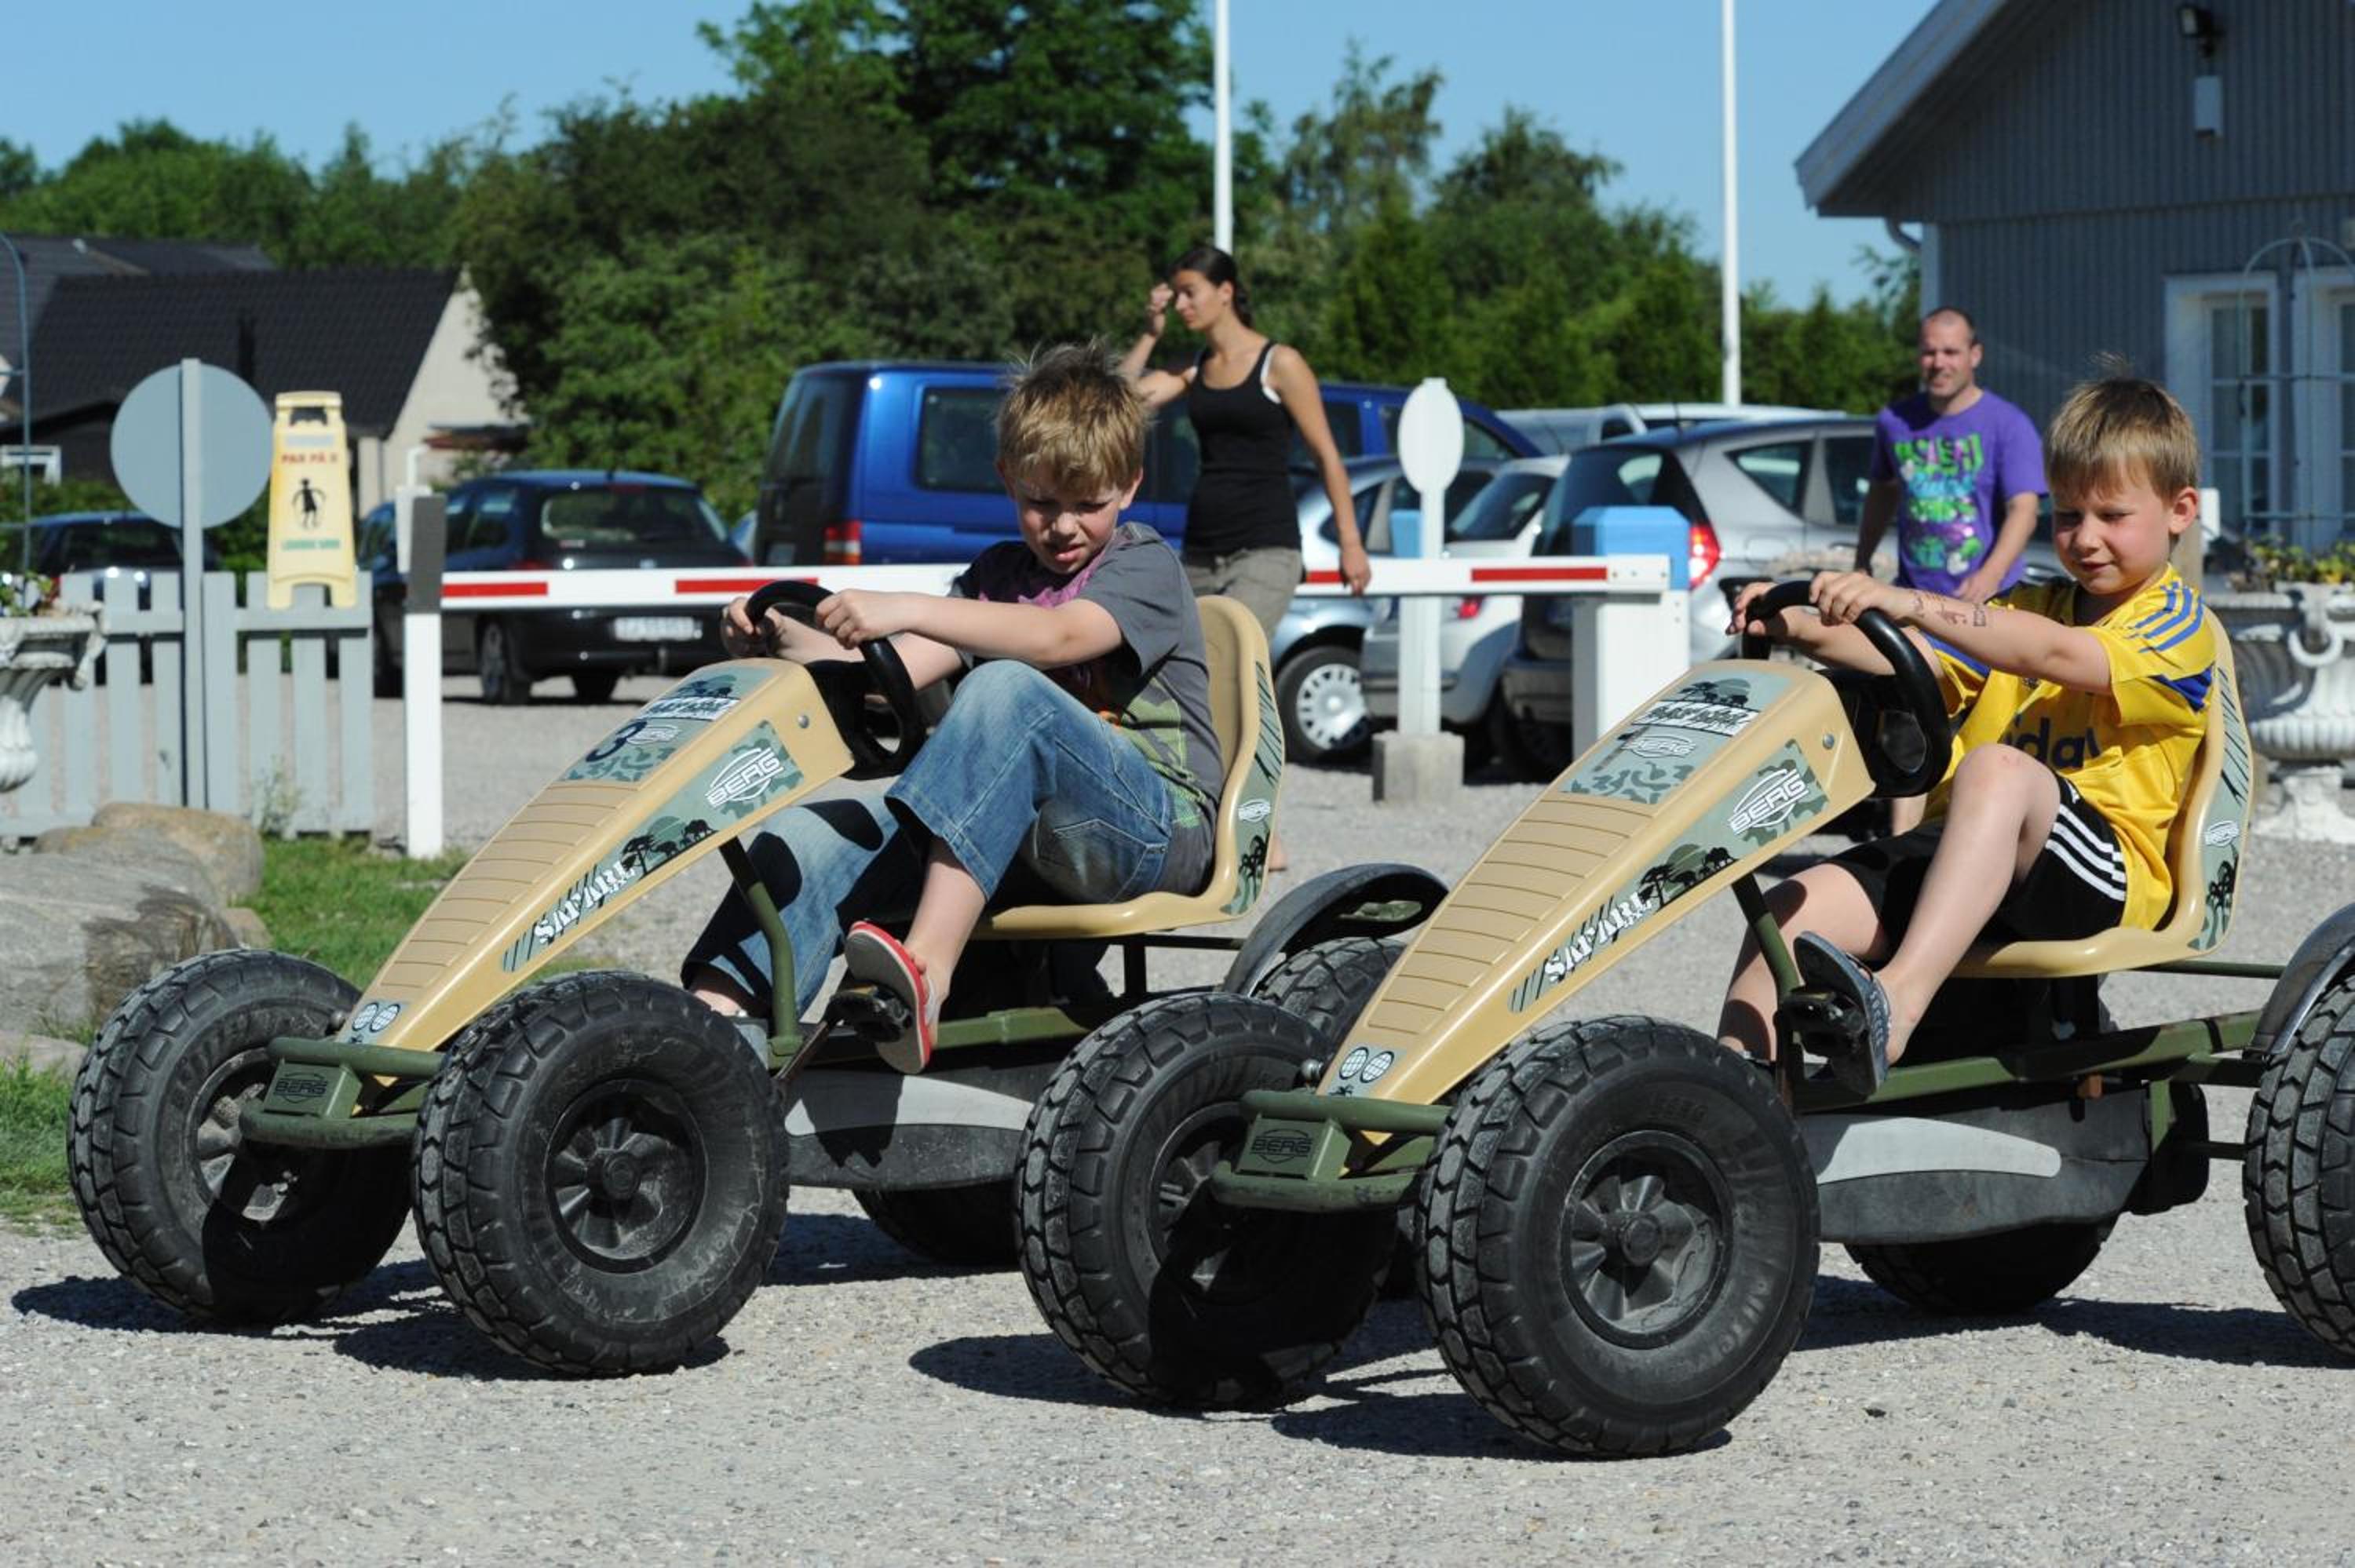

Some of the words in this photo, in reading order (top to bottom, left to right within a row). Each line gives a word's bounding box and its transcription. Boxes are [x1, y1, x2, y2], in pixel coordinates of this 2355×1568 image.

[706, 750, 783, 807] BERG
[1729, 771, 1809, 834] BERG
[535, 860, 635, 944] SAFARI
[1545, 892, 1652, 983] SAFARI
[274, 1079, 328, 1097] BERG
[1251, 1137, 1313, 1155] BERG
